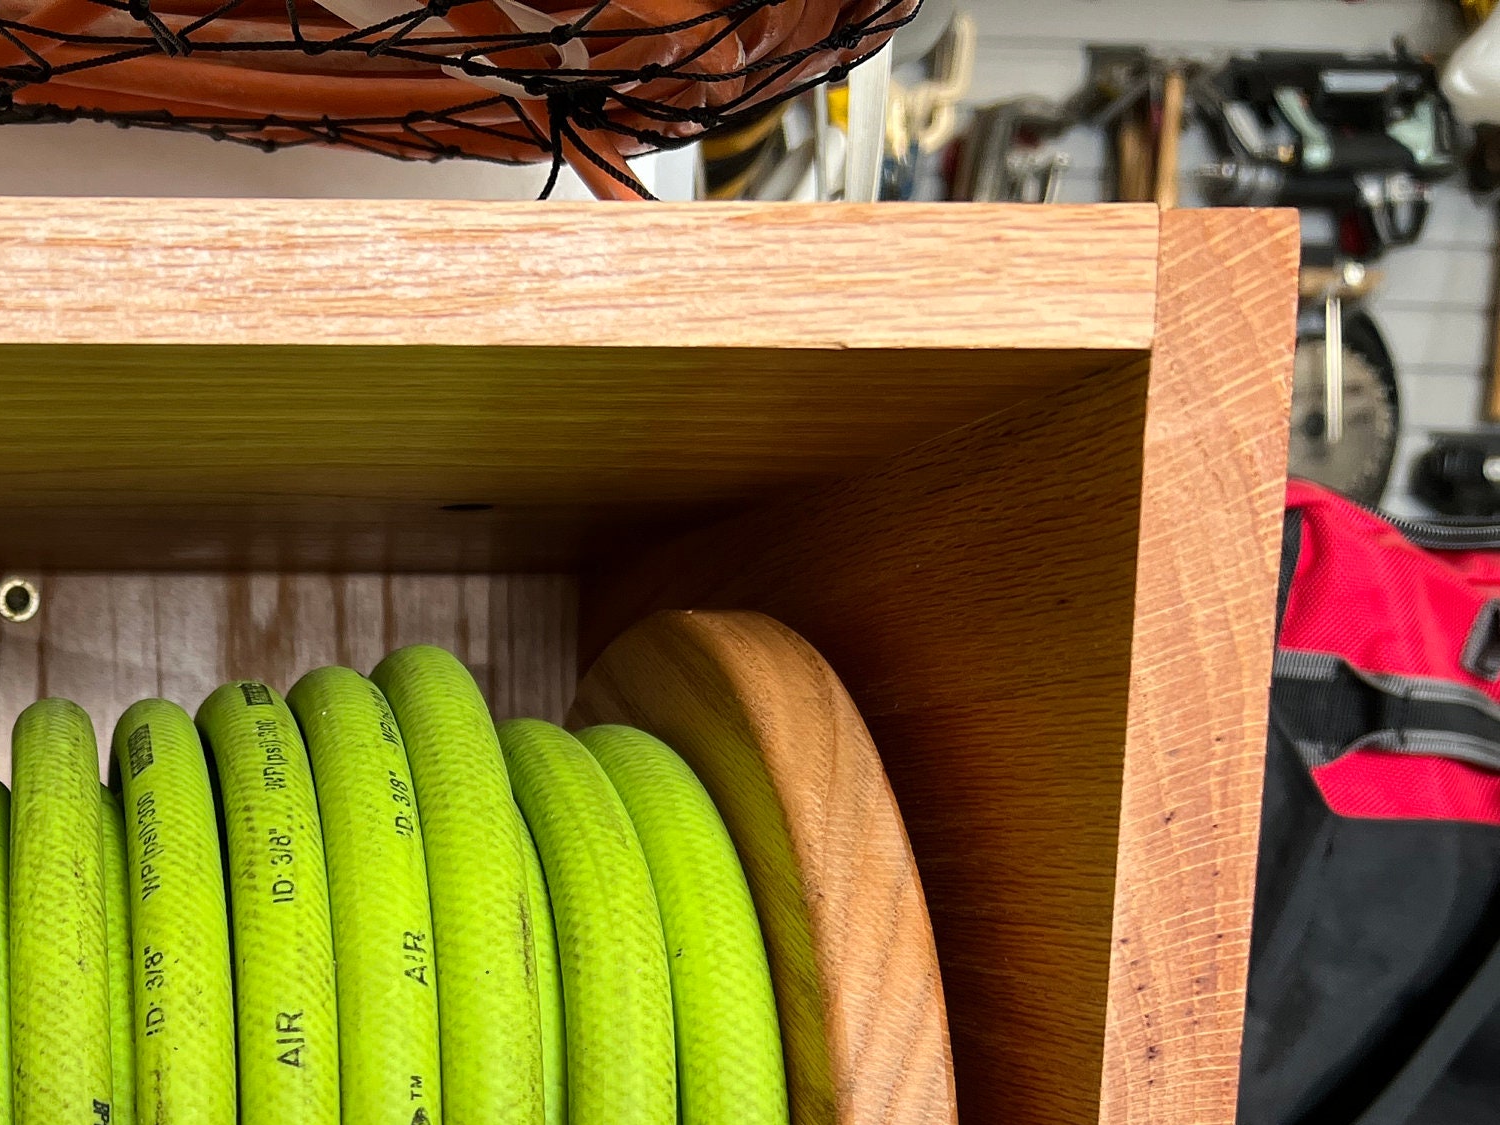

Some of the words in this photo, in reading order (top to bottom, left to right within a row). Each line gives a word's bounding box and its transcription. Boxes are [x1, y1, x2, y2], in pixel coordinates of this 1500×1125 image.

[389, 770, 412, 808] 3/8"
[269, 828, 293, 867] 3/8"
[272, 873, 295, 904] ID:
[144, 945, 164, 992] 3/8"
[403, 930, 429, 987] AIR
[146, 1001, 164, 1036] ID:
[276, 1008, 305, 1068] AIR
